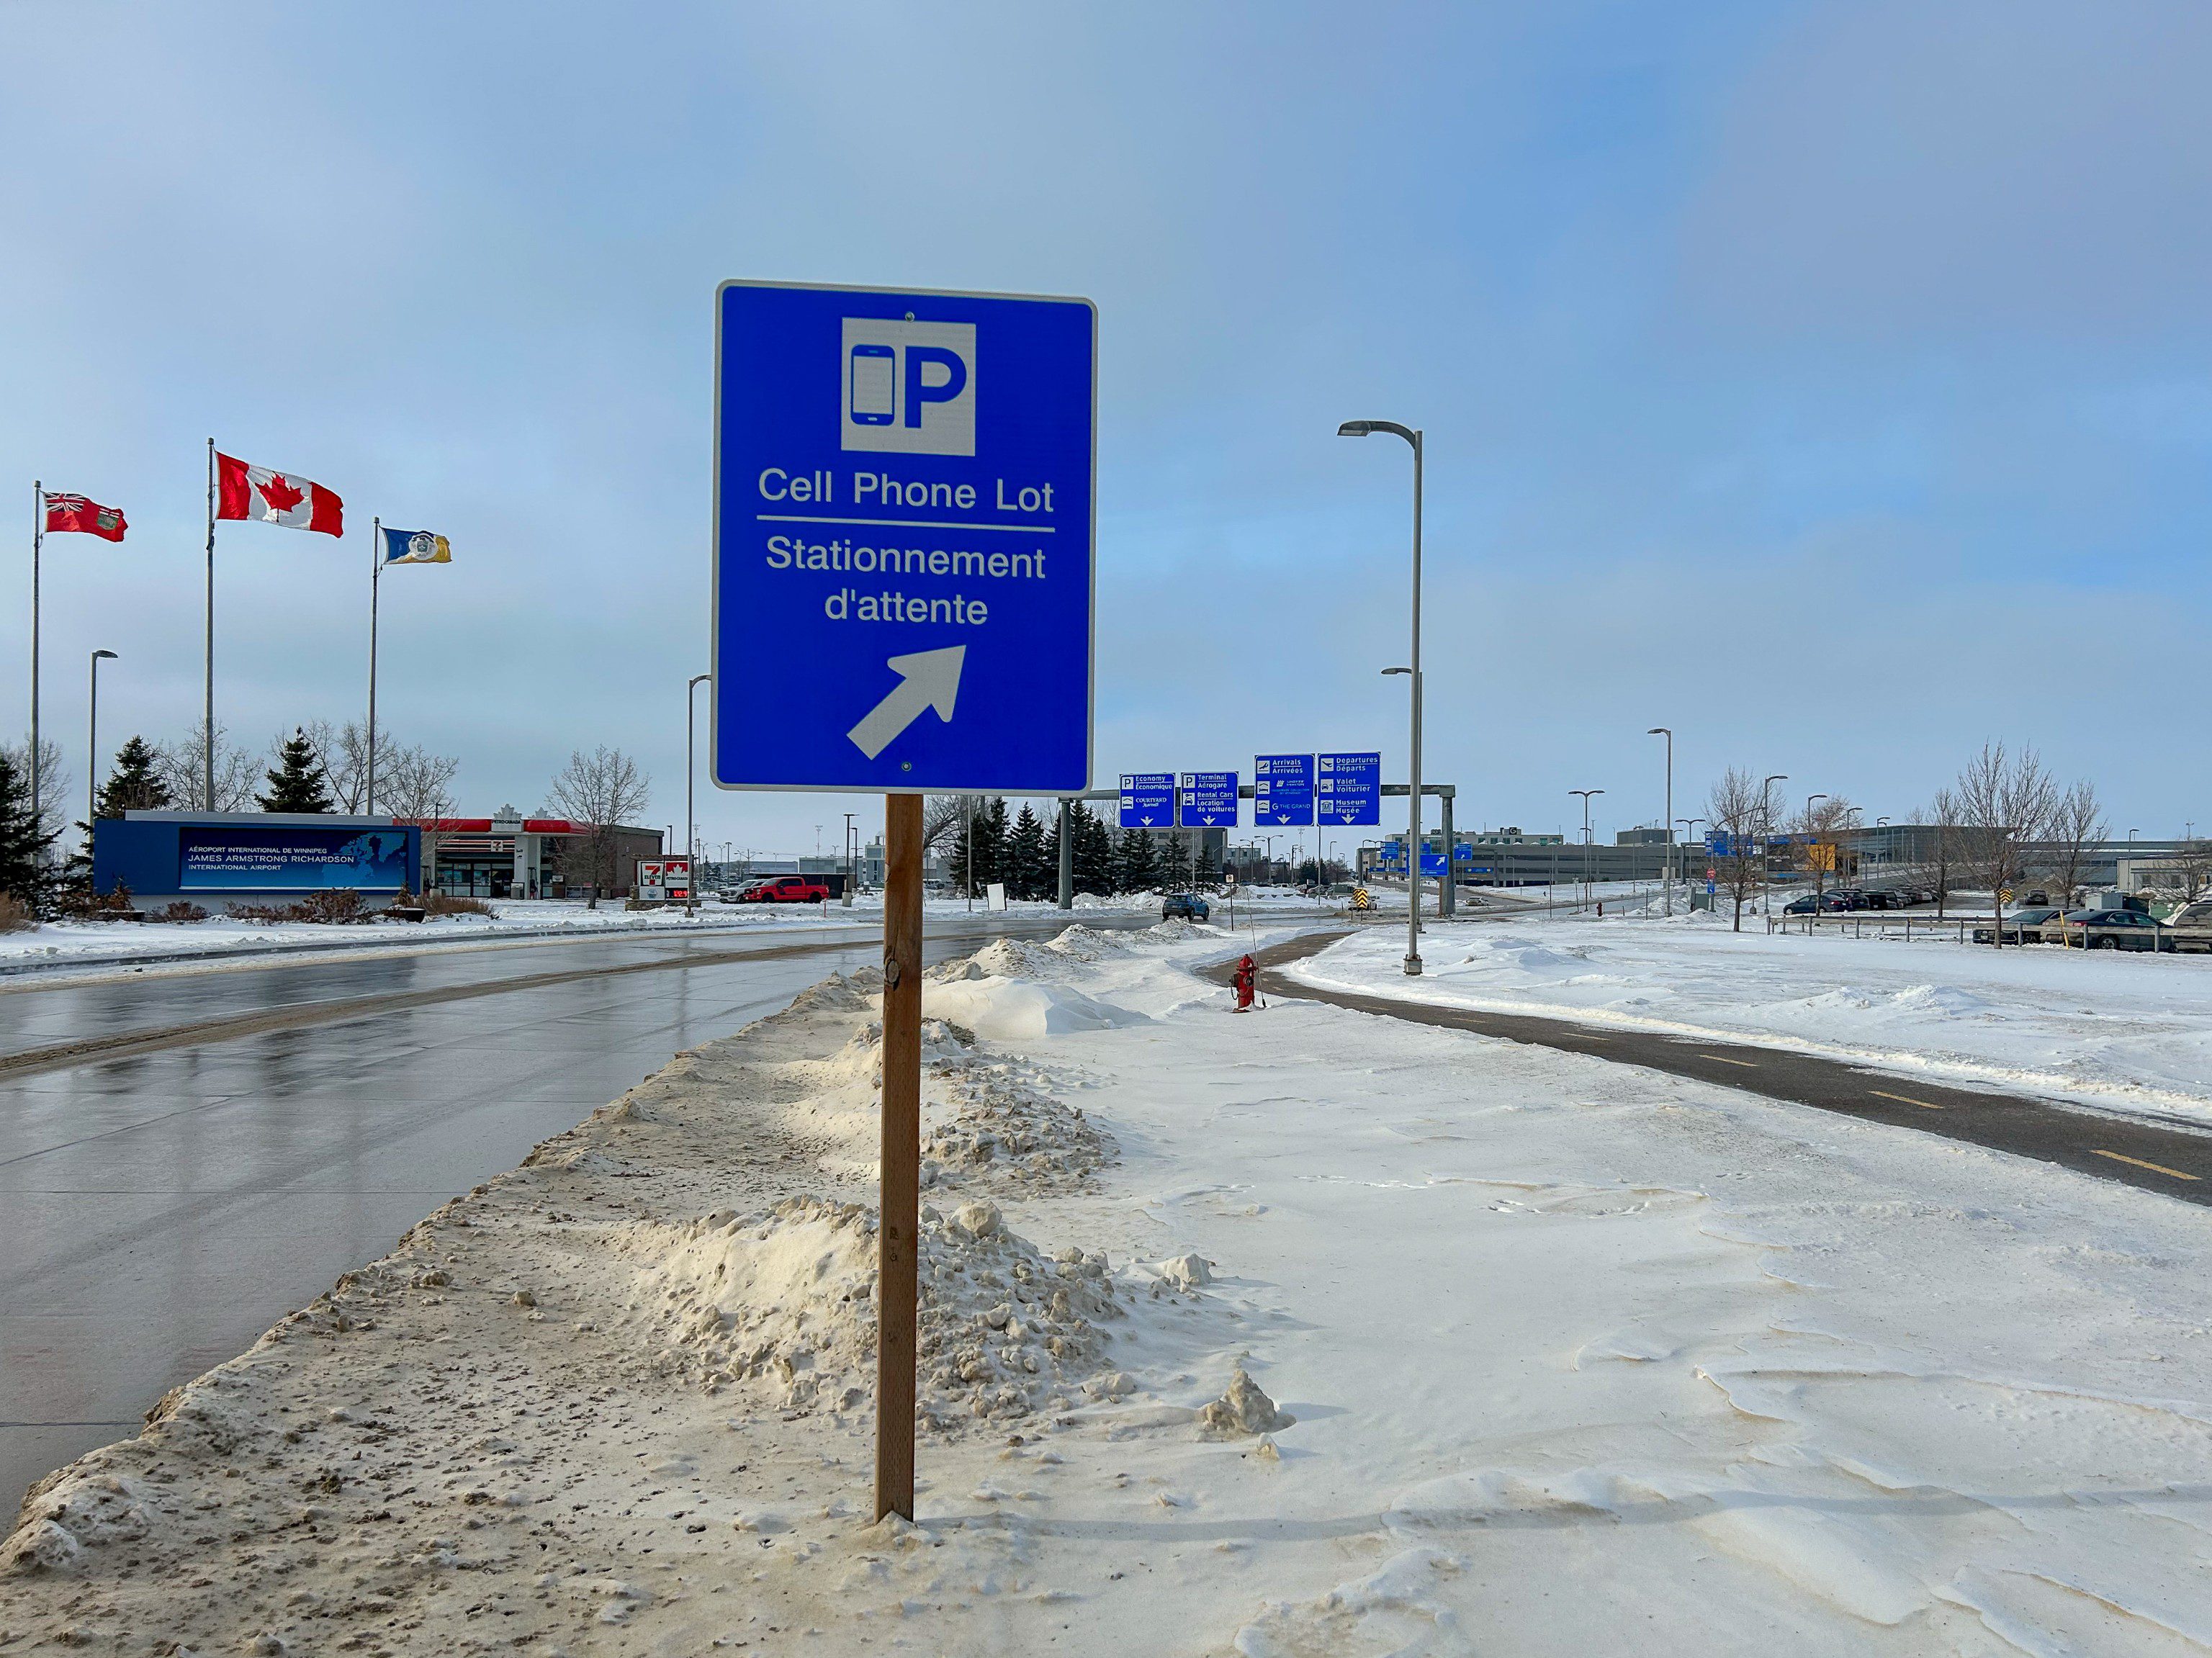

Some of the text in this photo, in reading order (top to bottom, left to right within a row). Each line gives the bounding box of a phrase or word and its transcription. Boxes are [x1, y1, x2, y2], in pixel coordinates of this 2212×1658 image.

[904, 346, 967, 429] P
[758, 467, 1055, 513] Cell Phone Lot
[765, 535, 1046, 579] Stationnement
[824, 589, 988, 625] d'attente
